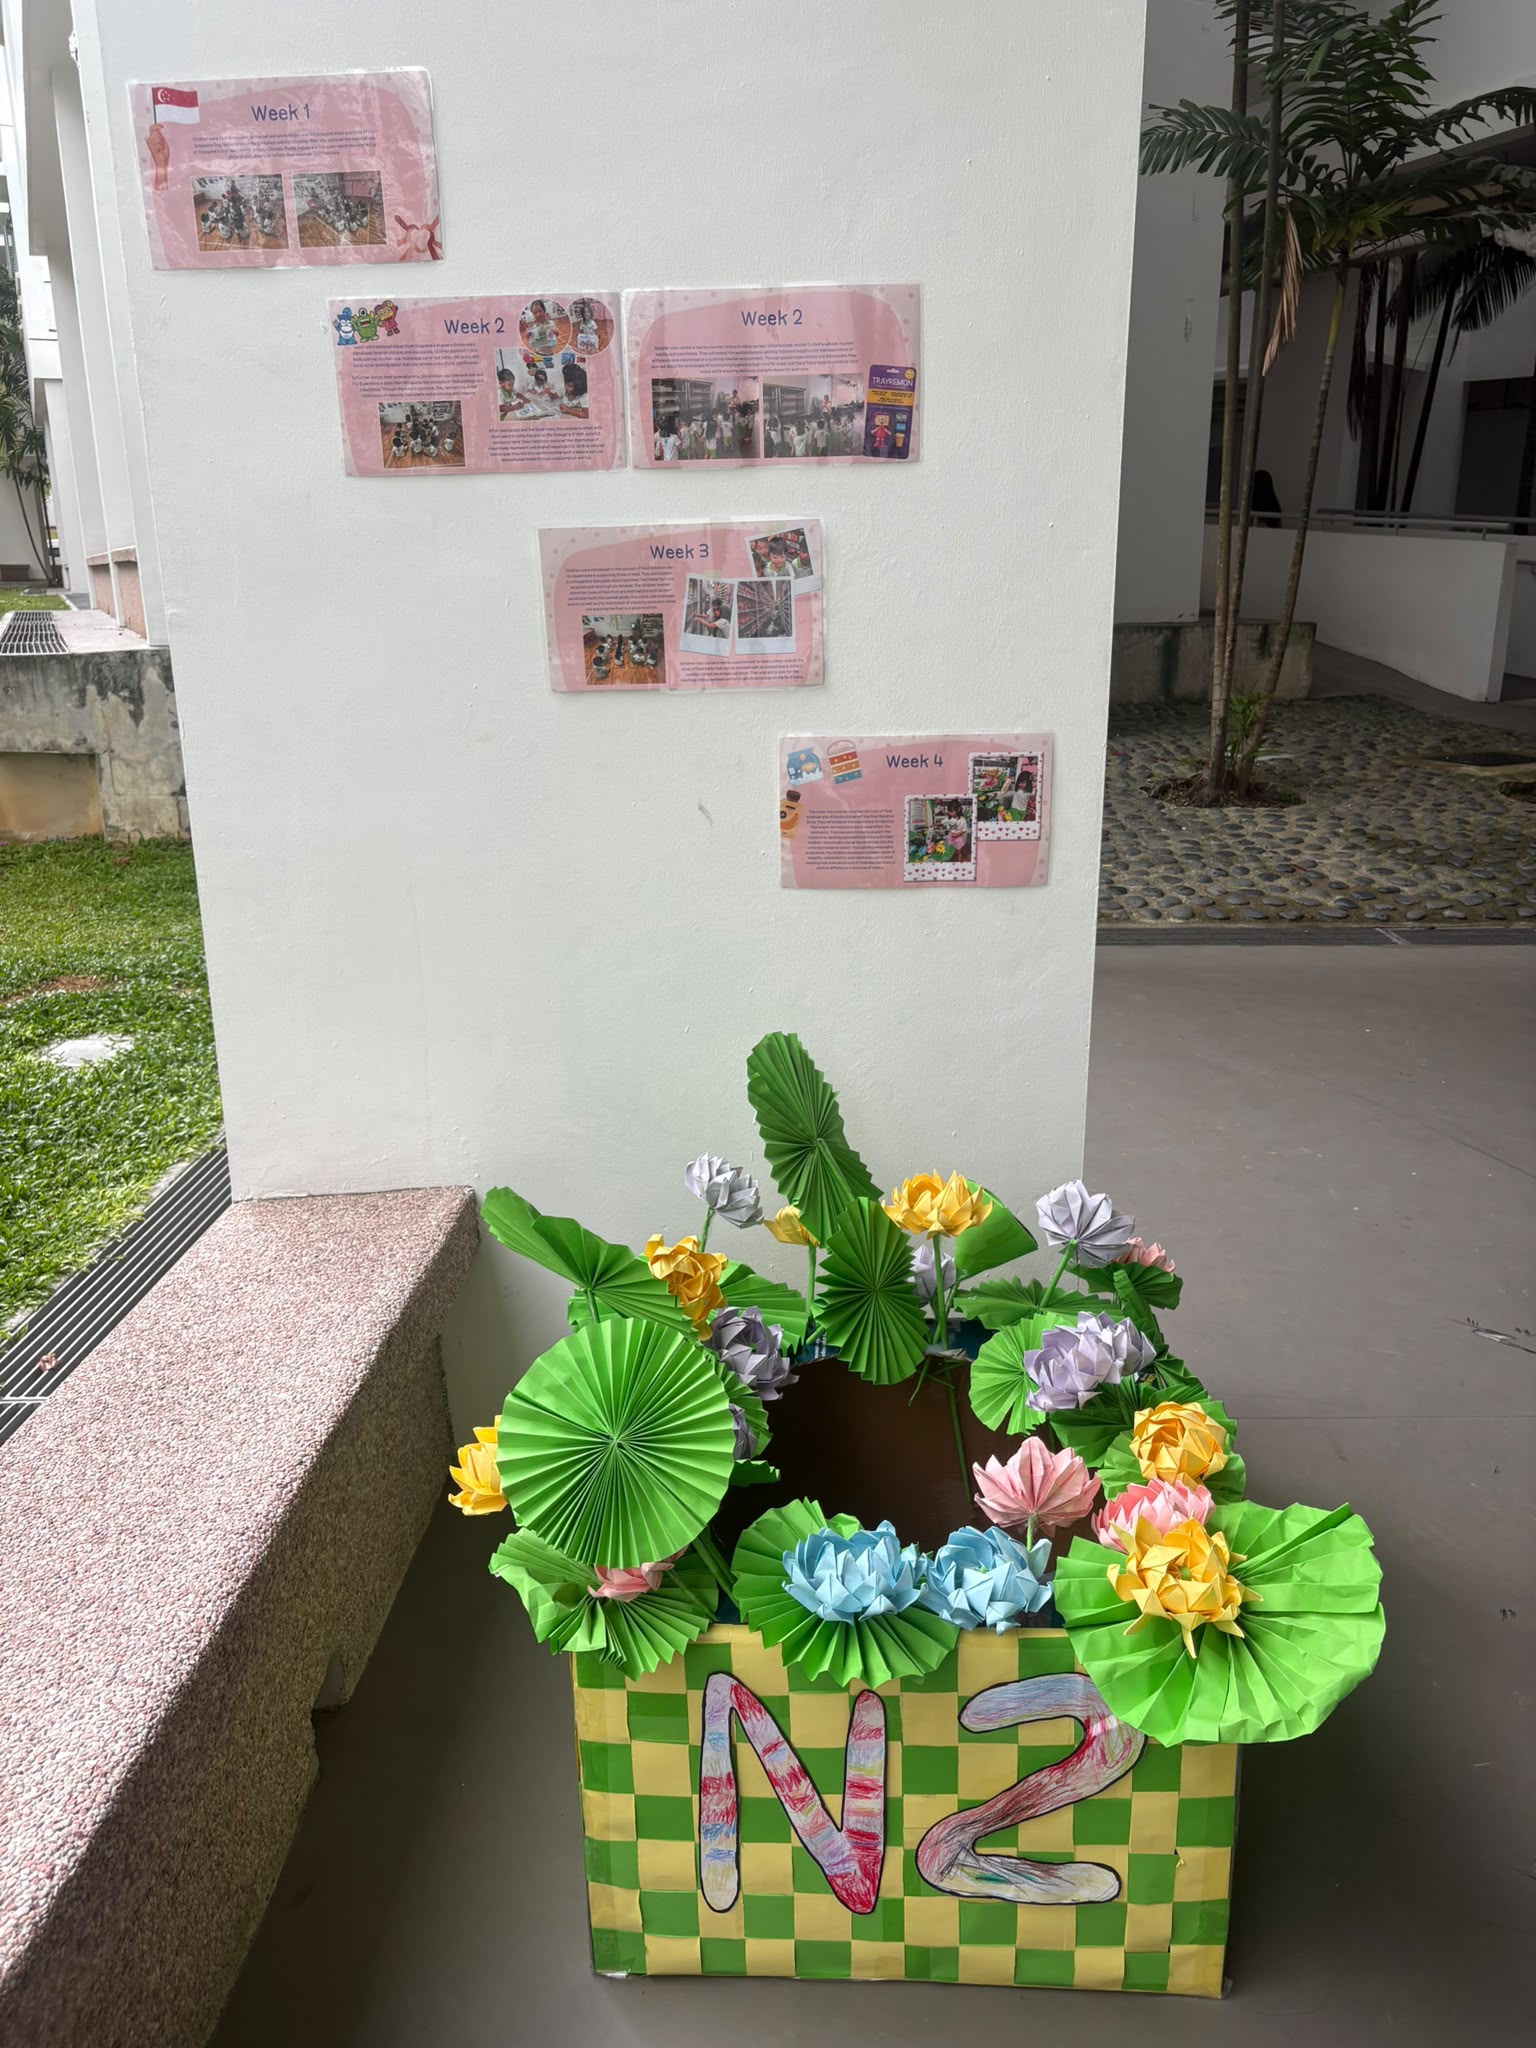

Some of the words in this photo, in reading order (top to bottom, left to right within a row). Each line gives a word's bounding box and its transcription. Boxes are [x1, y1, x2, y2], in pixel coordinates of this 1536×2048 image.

[250, 103, 299, 121] Week
[303, 103, 311, 119] 1
[443, 318, 490, 334] Week
[494, 316, 506, 333] 2
[740, 309, 788, 326] Week
[792, 308, 804, 324] 2
[649, 544, 695, 559] Week
[699, 543, 710, 558] 3
[886, 754, 929, 768] Week
[933, 753, 944, 767] 4
